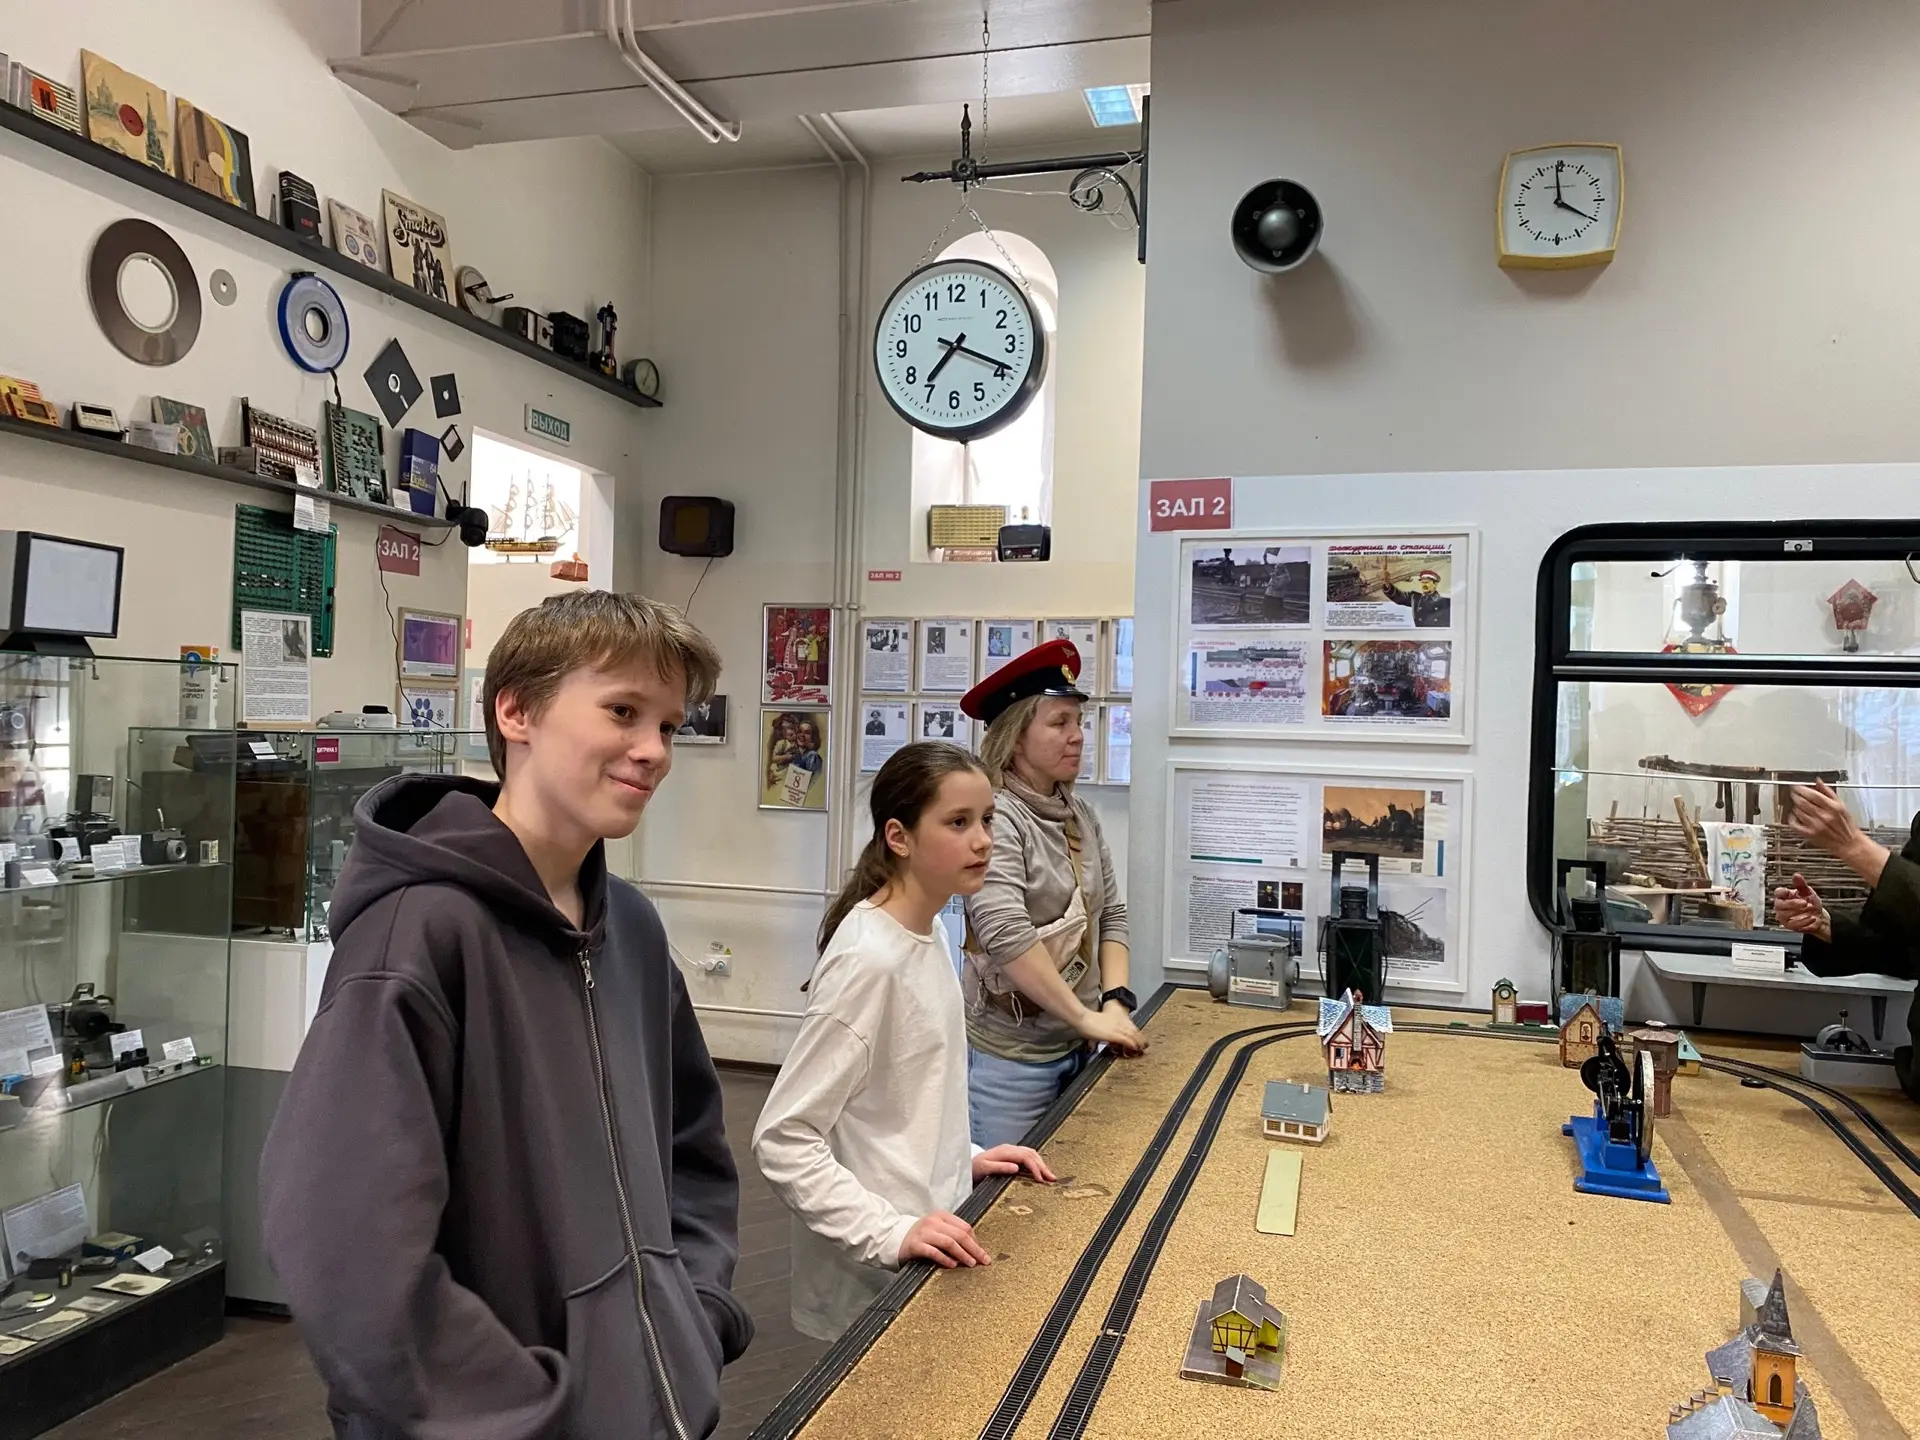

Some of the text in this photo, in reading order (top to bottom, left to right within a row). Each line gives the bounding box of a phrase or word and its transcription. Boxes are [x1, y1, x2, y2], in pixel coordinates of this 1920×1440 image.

[393, 209, 444, 246] Smokie
[925, 291, 939, 311] 11
[947, 283, 966, 303] 12
[979, 289, 986, 308] 1
[903, 314, 921, 334] 10
[995, 309, 1008, 329] 2
[896, 339, 907, 358] 9
[1004, 334, 1016, 353] 3
[905, 366, 917, 385] 8
[993, 362, 1006, 381] 4
[924, 384, 936, 403] 7
[949, 391, 960, 410] 6
[973, 382, 985, 401] 5
[532, 412, 568, 440] ВЫХОД
[1156, 496, 1225, 517] ЗАЛ 2
[381, 540, 419, 561] ЗАЛ 2
[793, 775, 801, 788] 8
